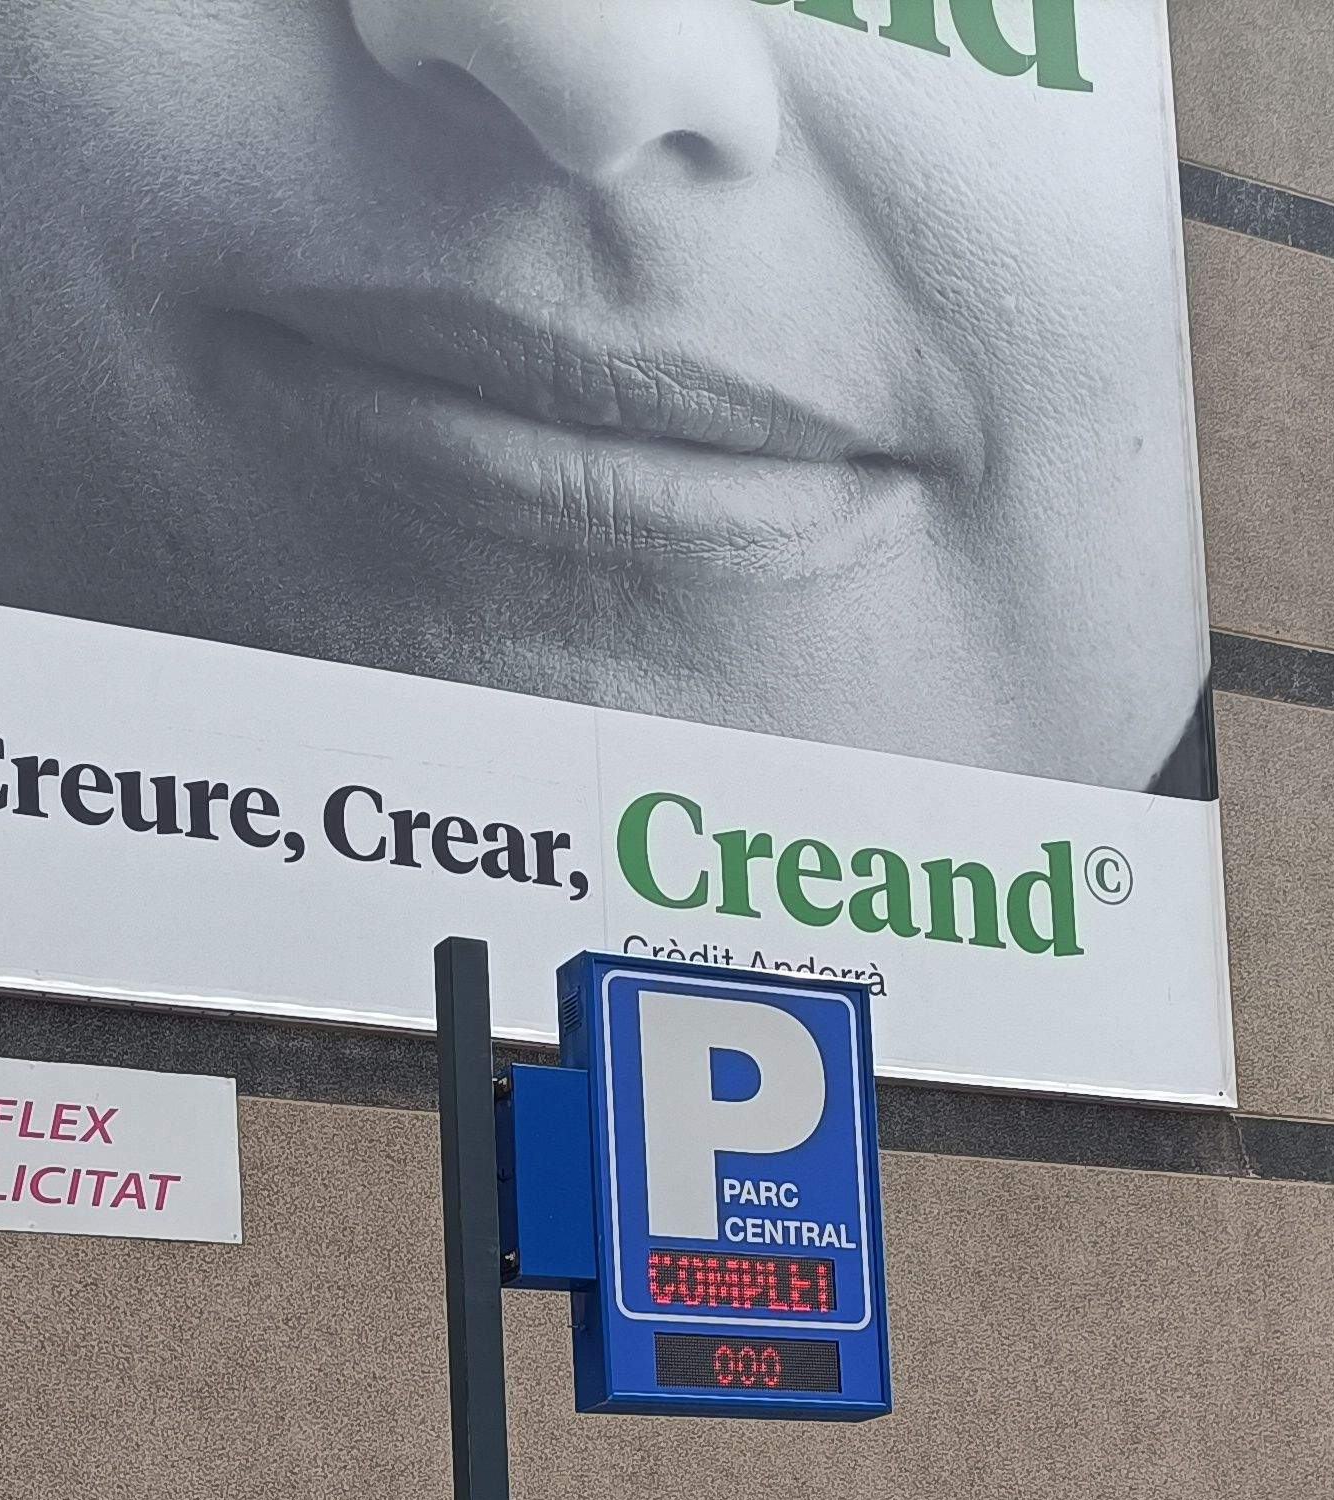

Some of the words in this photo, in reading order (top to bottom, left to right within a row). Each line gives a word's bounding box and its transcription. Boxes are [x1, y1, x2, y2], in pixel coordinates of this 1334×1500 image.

[322, 784, 589, 901] Crear,
[638, 990, 825, 1240] P
[723, 1178, 799, 1208] PARC
[724, 1216, 856, 1249] CENTRAL
[713, 1344, 782, 1386] 000
